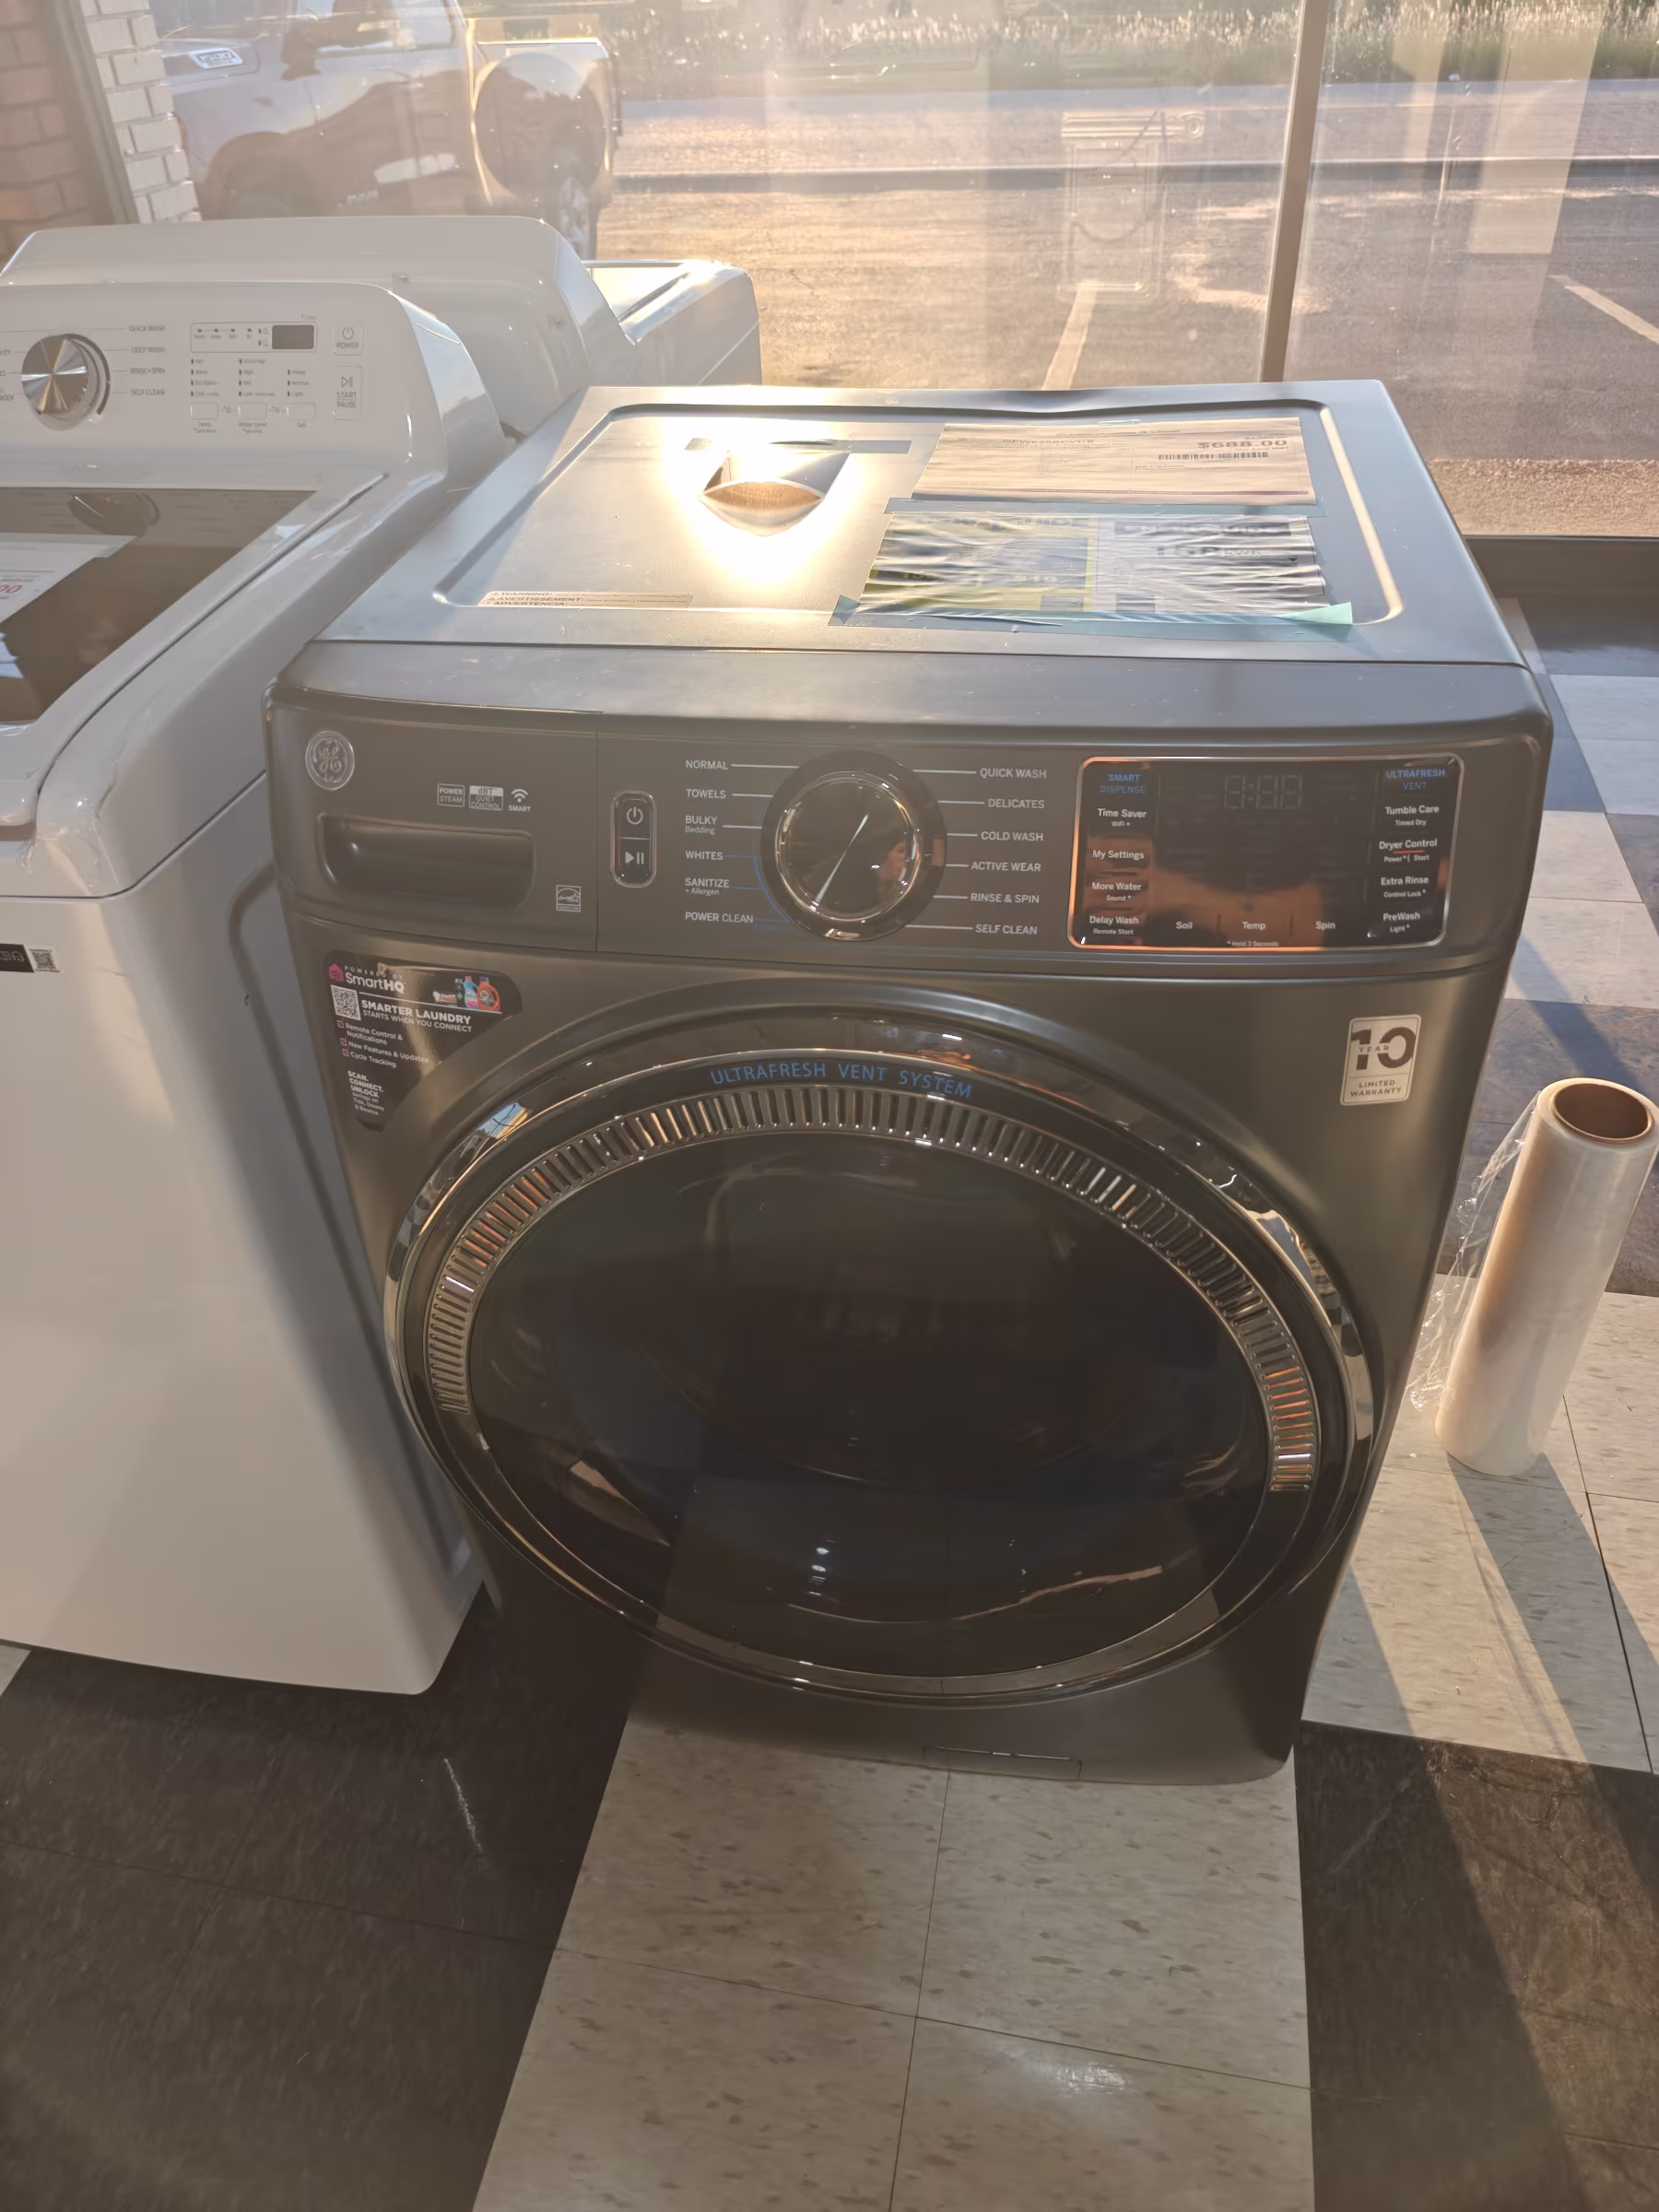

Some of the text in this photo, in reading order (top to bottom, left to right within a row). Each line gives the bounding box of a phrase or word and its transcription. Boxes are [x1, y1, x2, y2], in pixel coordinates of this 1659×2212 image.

[1197, 439, 1288, 450] $688.00
[685, 759, 729, 771] NORMAL
[980, 767, 1047, 779] QUICK WASH
[1108, 773, 1141, 782] SMART
[1385, 768, 1446, 780] ULTRAFRESH
[439, 787, 464, 795] POWER
[1100, 784, 1147, 794] DISPENSE
[1403, 781, 1428, 791] VENT
[685, 788, 726, 799] TOWELS
[439, 795, 463, 804] STEAM
[987, 798, 1045, 809] DELICATES
[470, 802, 501, 810] CONTROL
[1384, 805, 1440, 815] Tumble Care
[1097, 807, 1147, 818] Time Saver
[685, 815, 718, 825] BULKY
[1415, 818, 1427, 827] Dry
[685, 825, 715, 835] Bedding
[981, 831, 1043, 841] COLD WASH
[1379, 837, 1438, 851] Dryer Control
[685, 850, 724, 861] WHITES
[1092, 850, 1145, 861] My Settings
[971, 861, 1041, 872] ACTIVE WEAR
[685, 877, 730, 888] SANITIZE
[1091, 881, 1143, 891] More Water
[1381, 876, 1430, 886] Extra Rinse
[690, 887, 720, 897] Allergen
[971, 892, 1040, 904] RINSE & SPIN
[685, 911, 754, 924] POWER CLEAN
[1089, 915, 1139, 925] Delay Wash
[1382, 912, 1420, 922] PreWash
[975, 924, 1038, 935] SELF CLEAN
[1175, 921, 1336, 931] Soil Temp Spin
[345, 971, 406, 994] SmartHQ
[360, 999, 472, 1025] SMARTER LAUNDRY
[362, 1009, 473, 1032] STARTS WHEN YOU CONNECT
[345, 1022, 371, 1034] Remote
[371, 1029, 396, 1041] Control
[347, 1030, 387, 1045] Notifications
[348, 1041, 362, 1050] New
[363, 1044, 393, 1057] Features
[399, 1053, 430, 1064] Updates
[1349, 1026, 1417, 1071] 10
[1358, 1044, 1390, 1053] YEAR
[350, 1051, 397, 1069] Cycle Tracking
[709, 1062, 973, 1099] ULTRAFRESH VENT SYSTEM
[1359, 1079, 1396, 1088] LIMITED
[1349, 1087, 1403, 1098] WARRANTY
